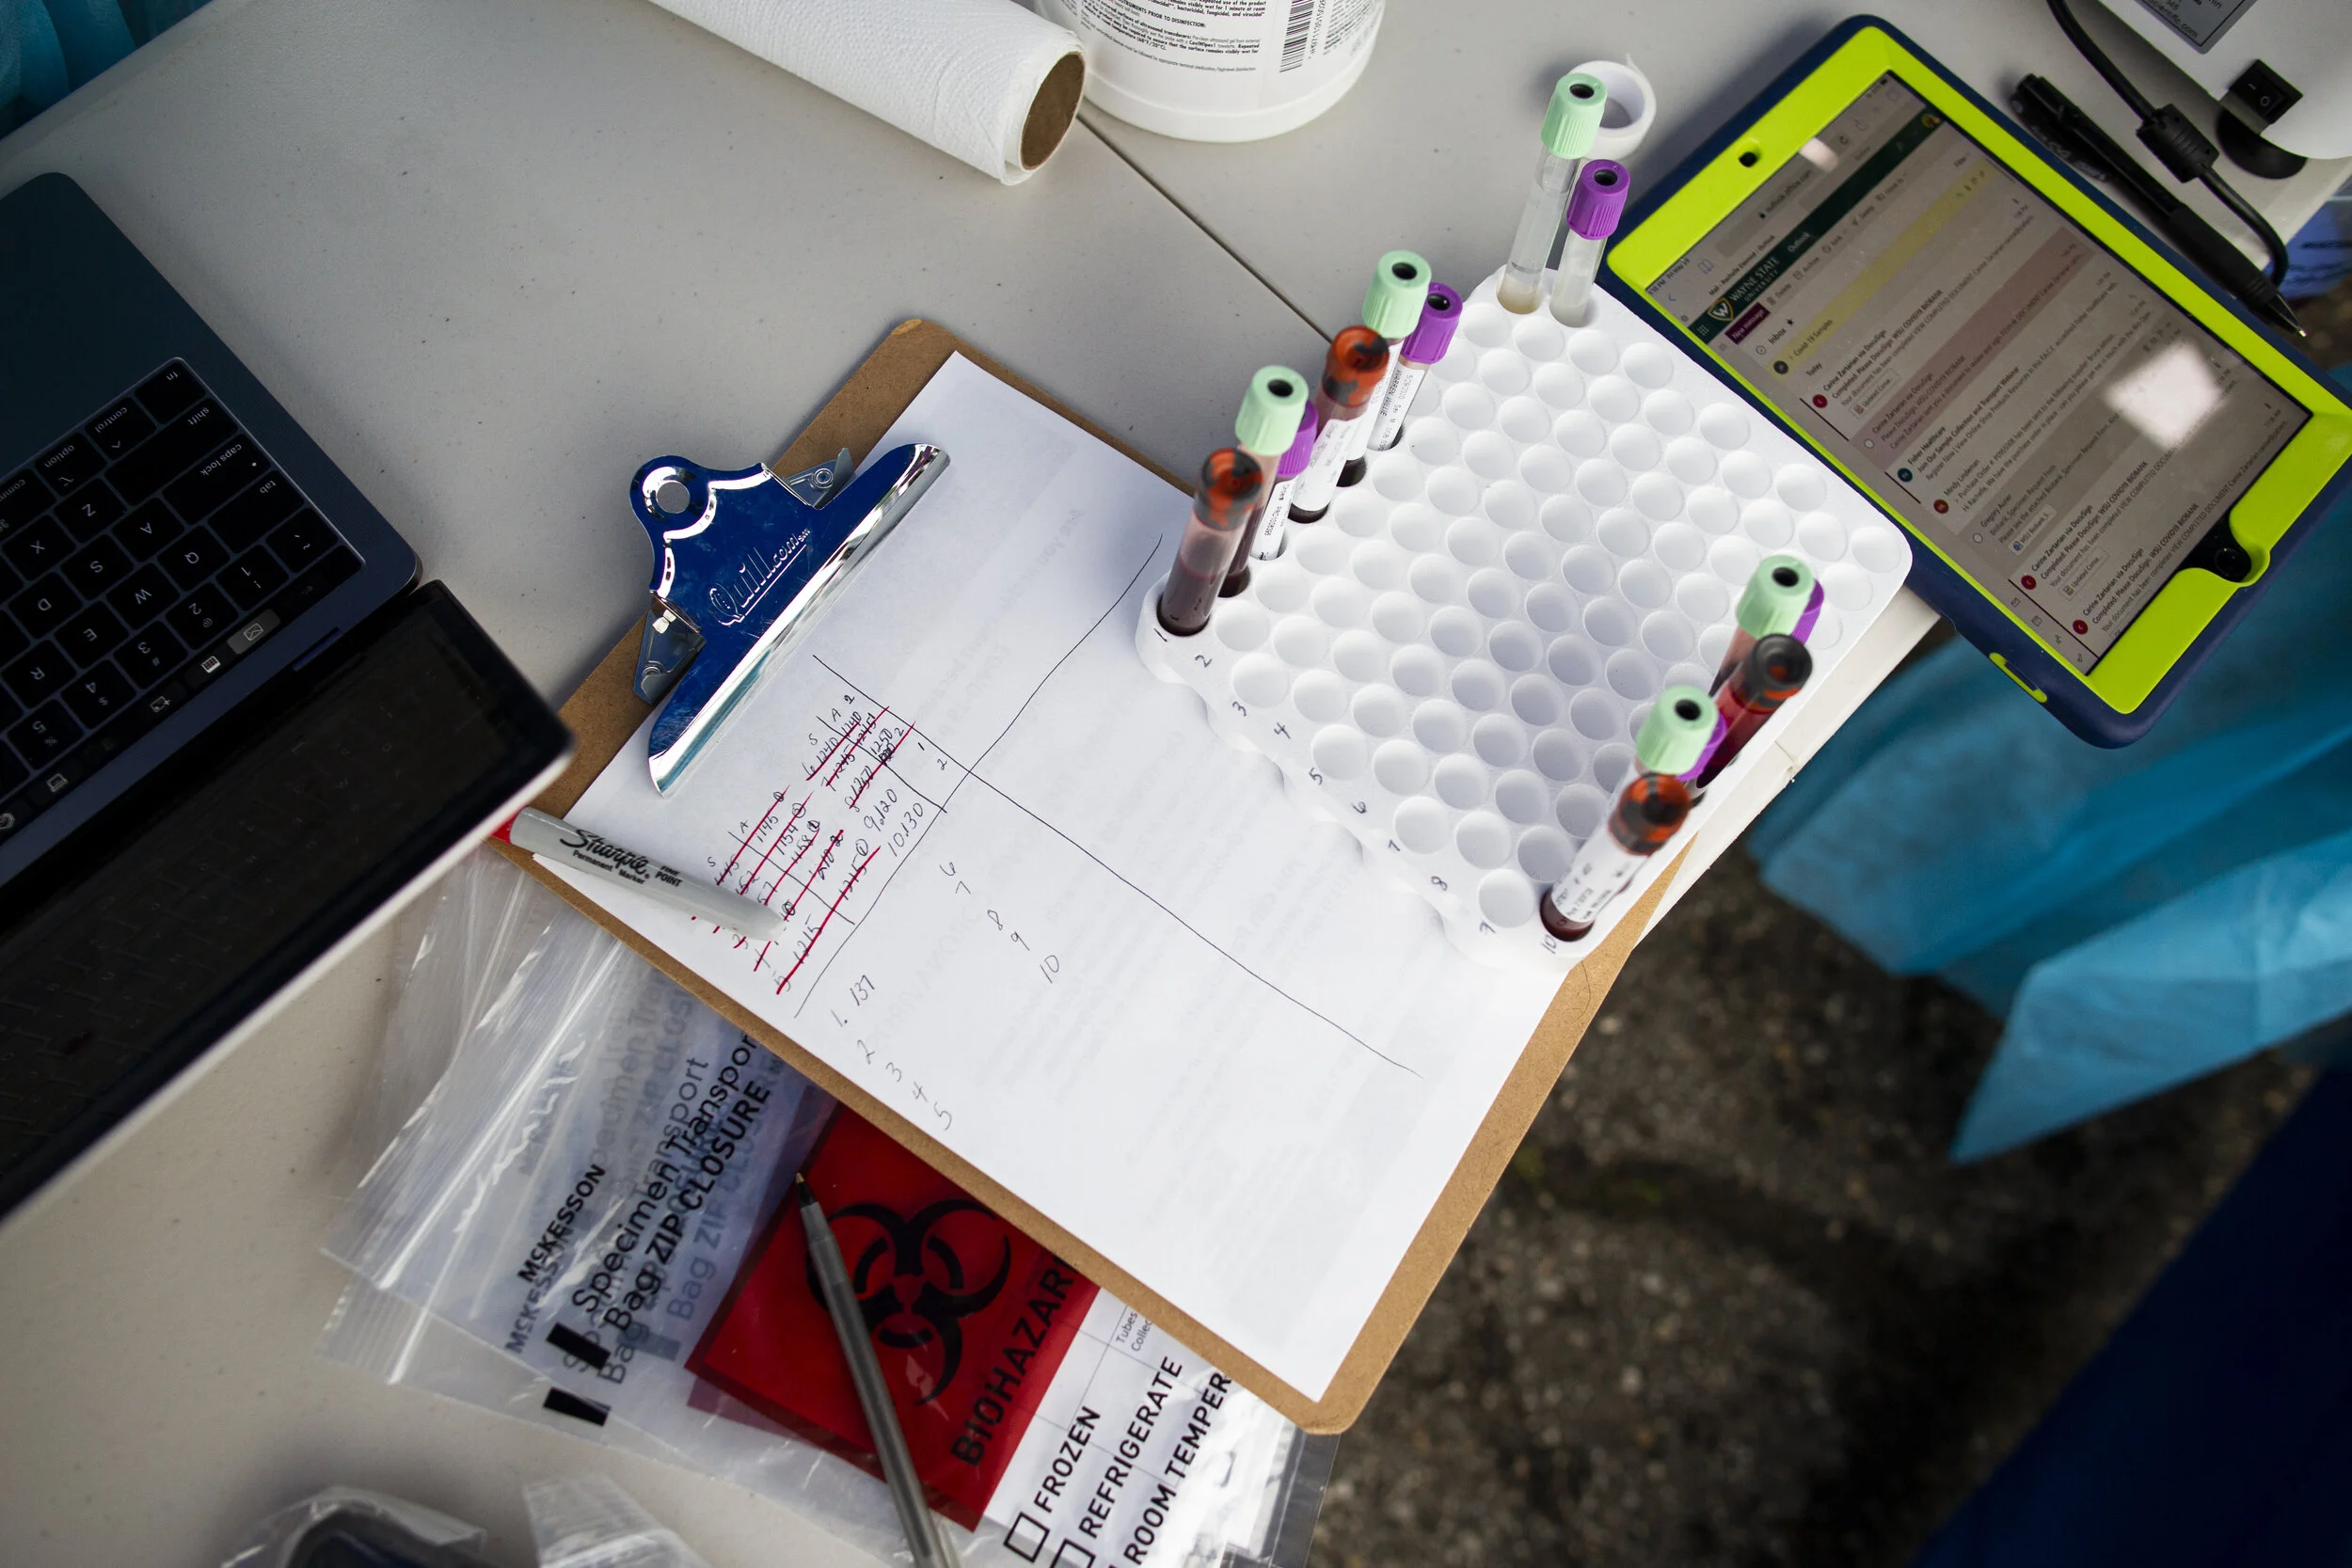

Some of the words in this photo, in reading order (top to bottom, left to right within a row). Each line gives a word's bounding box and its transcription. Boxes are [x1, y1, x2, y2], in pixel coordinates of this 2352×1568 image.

[1148, 10, 1162, 19] PRIOR
[1171, 18, 1206, 27] DISINFECTION:
[1726, 275, 1759, 304] WAYNE
[1752, 254, 1781, 280] STATE
[1742, 268, 1780, 303] UNIVERSITY
[1730, 325, 1746, 340] New
[1740, 307, 1767, 330] message
[1765, 325, 1788, 345] Inbox
[1804, 360, 1824, 378] Today
[1821, 374, 1840, 391] Carine
[1836, 355, 1860, 378] Zartarian
[1855, 348, 1867, 358] via
[1863, 327, 1888, 352] DocuSign
[167, 371, 180, 381] fn
[1389, 370, 1403, 396] WARREN
[95, 405, 128, 435] control
[188, 406, 210, 426] shift
[1915, 460, 1929, 473] Join
[1925, 451, 1938, 464] Our
[1934, 435, 1955, 455] Sample
[1949, 413, 1975, 437] Collection
[1971, 404, 1984, 416] and
[1979, 384, 2004, 408] Transport
[1999, 365, 2021, 387] Webinar
[44, 444, 75, 469] option
[219, 443, 243, 462] caps
[1906, 448, 1923, 465] Fisher
[1920, 424, 1947, 451] Healthcare
[199, 458, 221, 477] lock
[1943, 479, 1961, 498] Mindy
[1956, 457, 1980, 482] Lindeman
[260, 480, 278, 495] tab
[1979, 507, 2001, 529] Gregory
[1996, 493, 2013, 510] Auner
[2063, 535, 2080, 553] Please
[2097, 500, 2112, 515] WSU
[2107, 481, 2130, 503] COVID19
[2125, 460, 2149, 483] BIOBANK
[2030, 553, 2048, 572] Carine
[2043, 532, 2067, 557] Zartarian
[2063, 525, 2074, 535] via
[2070, 503, 2094, 529] DocuSign
[2048, 574, 2062, 588] Your
[2058, 551, 2083, 577] document
[2078, 542, 2090, 554] has
[2087, 531, 2101, 546] been
[2097, 507, 2123, 534] completed
[2118, 495, 2133, 510] VIEW
[2129, 467, 2157, 498] COMPLETED
[2115, 578, 2132, 597] Please
[2148, 544, 2163, 559] WSU
[2158, 523, 2180, 546] COVID19
[2176, 501, 2199, 527] BIOBANK
[709, 534, 801, 627] Quill.com
[2070, 568, 2090, 589] Updated
[2081, 597, 2099, 616] Carine
[2095, 576, 2118, 601] Zartarian
[2114, 569, 2124, 578] via
[2121, 546, 2145, 573] DocuSign
[1194, 654, 1213, 668] 2
[1232, 701, 1247, 717] 3
[809, 733, 818, 746] S
[832, 707, 842, 722] A
[1273, 721, 1291, 739] 4
[870, 728, 893, 755] 1250
[1309, 768, 1323, 785] 5
[1351, 800, 1367, 815] 6
[1388, 839, 1401, 852] 7
[572, 849, 614, 873] Permanent
[618, 868, 645, 885] Marker
[655, 871, 684, 888] POINT
[660, 865, 681, 876] FINE
[939, 862, 957, 877] 6
[955, 880, 972, 895] 7
[1430, 875, 1448, 892] 8
[987, 909, 1003, 930] 8
[1010, 931, 1030, 951] 9
[1540, 933, 1557, 955] 10
[1040, 955, 1060, 984] 10
[850, 974, 875, 1006] 137
[857, 1038, 875, 1065] 2
[885, 1062, 902, 1082] 3
[912, 1081, 928, 1102] 4
[933, 1101, 953, 1131] 5
[572, 1161, 681, 1314] Specimen
[662, 1032, 759, 1148] Transpor
[602, 1270, 662, 1333] Bag
[645, 1212, 686, 1263] ZIP
[679, 1079, 771, 1213] CLOSURE
[667, 1257, 718, 1321] Bag
[1116, 1310, 1138, 1345] Tubes
[951, 1255, 1079, 1466] BIOHAZAR
[1035, 1405, 1102, 1513] FROZEN
[1079, 1355, 1184, 1540] REFRIGERATE
[1124, 1482, 1178, 1567] ROOM
[1166, 1371, 1232, 1488] TEMPER
